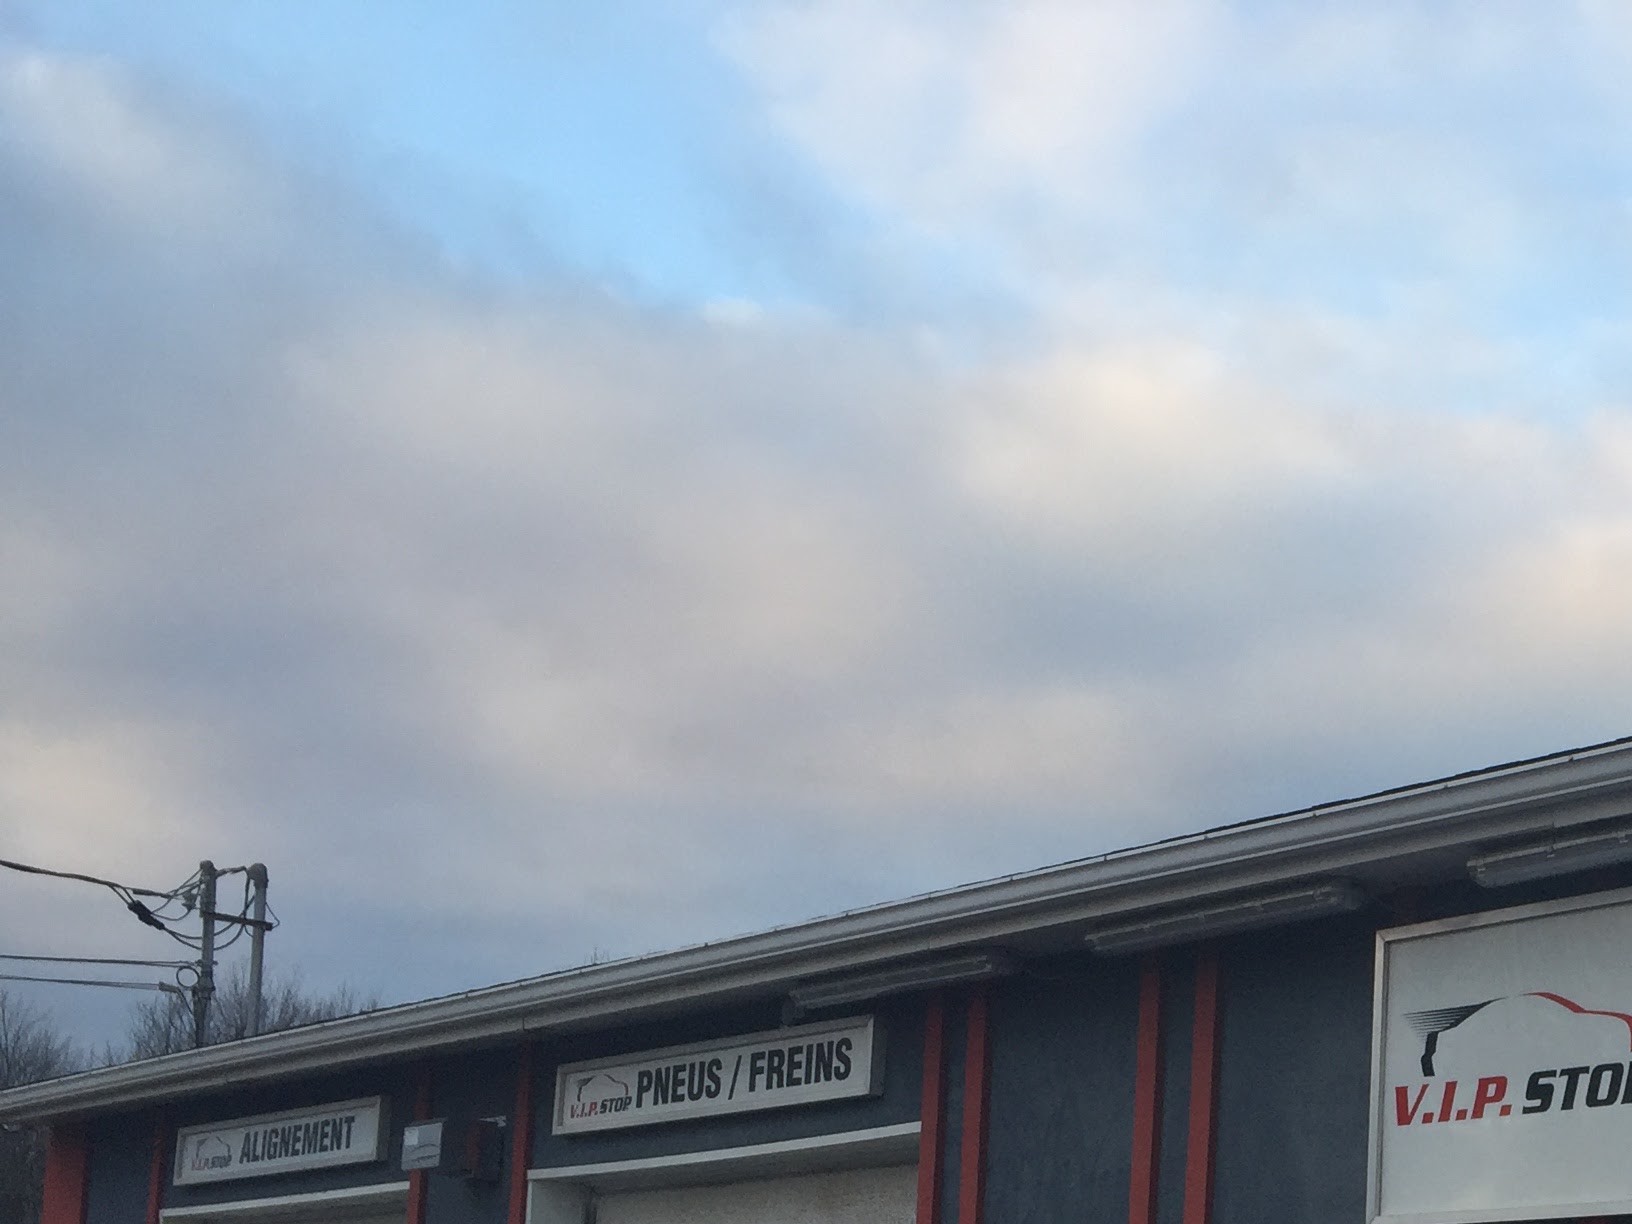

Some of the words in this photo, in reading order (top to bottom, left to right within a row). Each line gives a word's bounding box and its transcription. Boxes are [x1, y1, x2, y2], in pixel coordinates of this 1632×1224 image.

[635, 1058, 723, 1108] PNEUS
[748, 1036, 853, 1093] FREINS
[599, 1096, 632, 1114] STOP
[1394, 1075, 1513, 1127] V.I.P.
[238, 1115, 356, 1165] ALIGNEMENT
